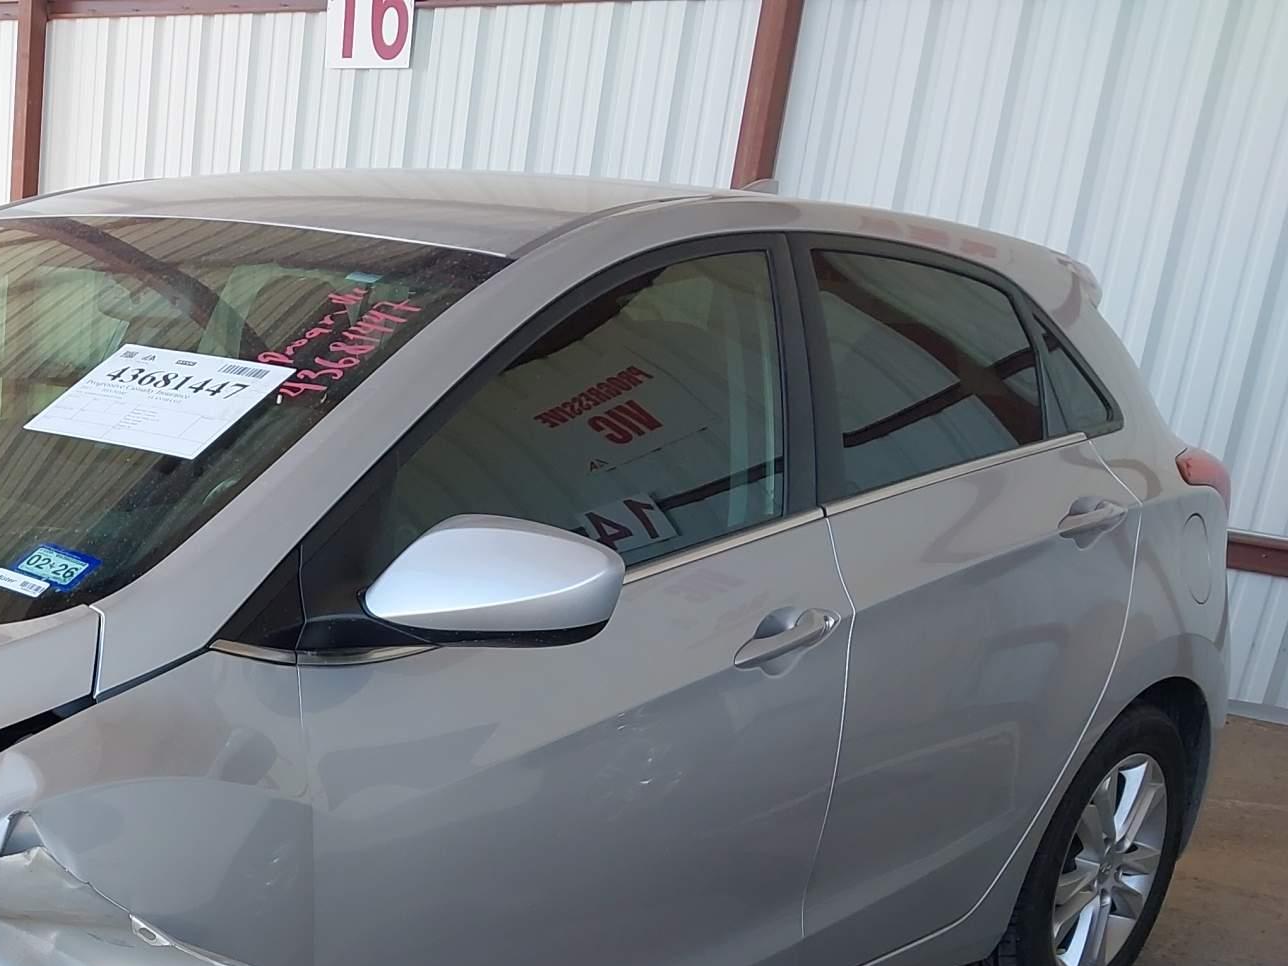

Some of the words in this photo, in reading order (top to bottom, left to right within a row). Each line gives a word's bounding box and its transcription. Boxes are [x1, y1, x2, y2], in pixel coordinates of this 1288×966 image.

[342, 0, 409, 60] 16
[106, 366, 250, 399] 43681447
[26, 554, 52, 570] 02
[52, 563, 79, 579] 26
